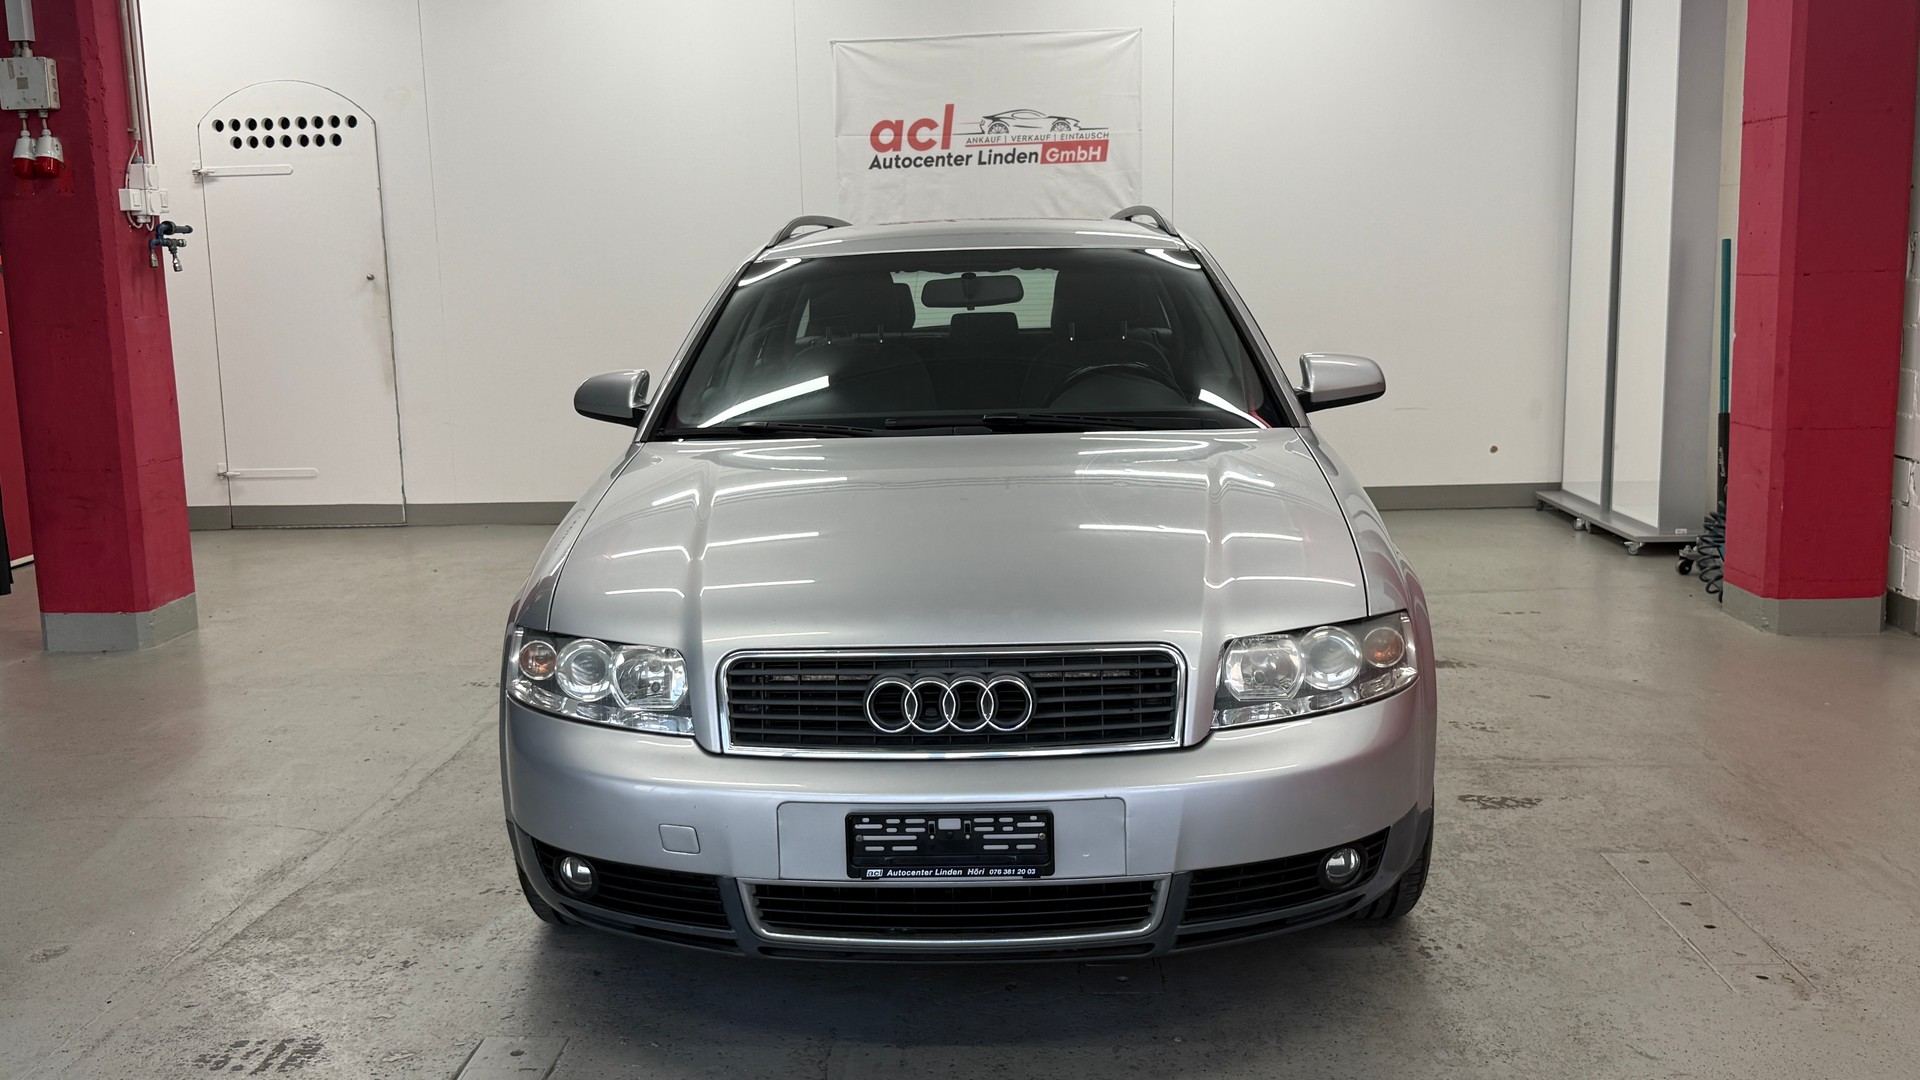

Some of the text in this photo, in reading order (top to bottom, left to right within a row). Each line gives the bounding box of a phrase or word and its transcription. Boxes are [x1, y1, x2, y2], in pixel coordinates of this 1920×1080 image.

[870, 103, 955, 153] acl
[966, 131, 1110, 144] ANKAUF VERKAUF EINTAUSCH
[868, 146, 1102, 170] Autocenter Linden GmbH
[886, 869, 934, 877] Autocenter
[934, 868, 963, 876] Linden
[967, 868, 986, 876] Höri
[989, 868, 1002, 876] 076
[1003, 868, 1015, 876] 381
[1016, 868, 1026, 876] 20
[1026, 868, 1036, 876] 03
